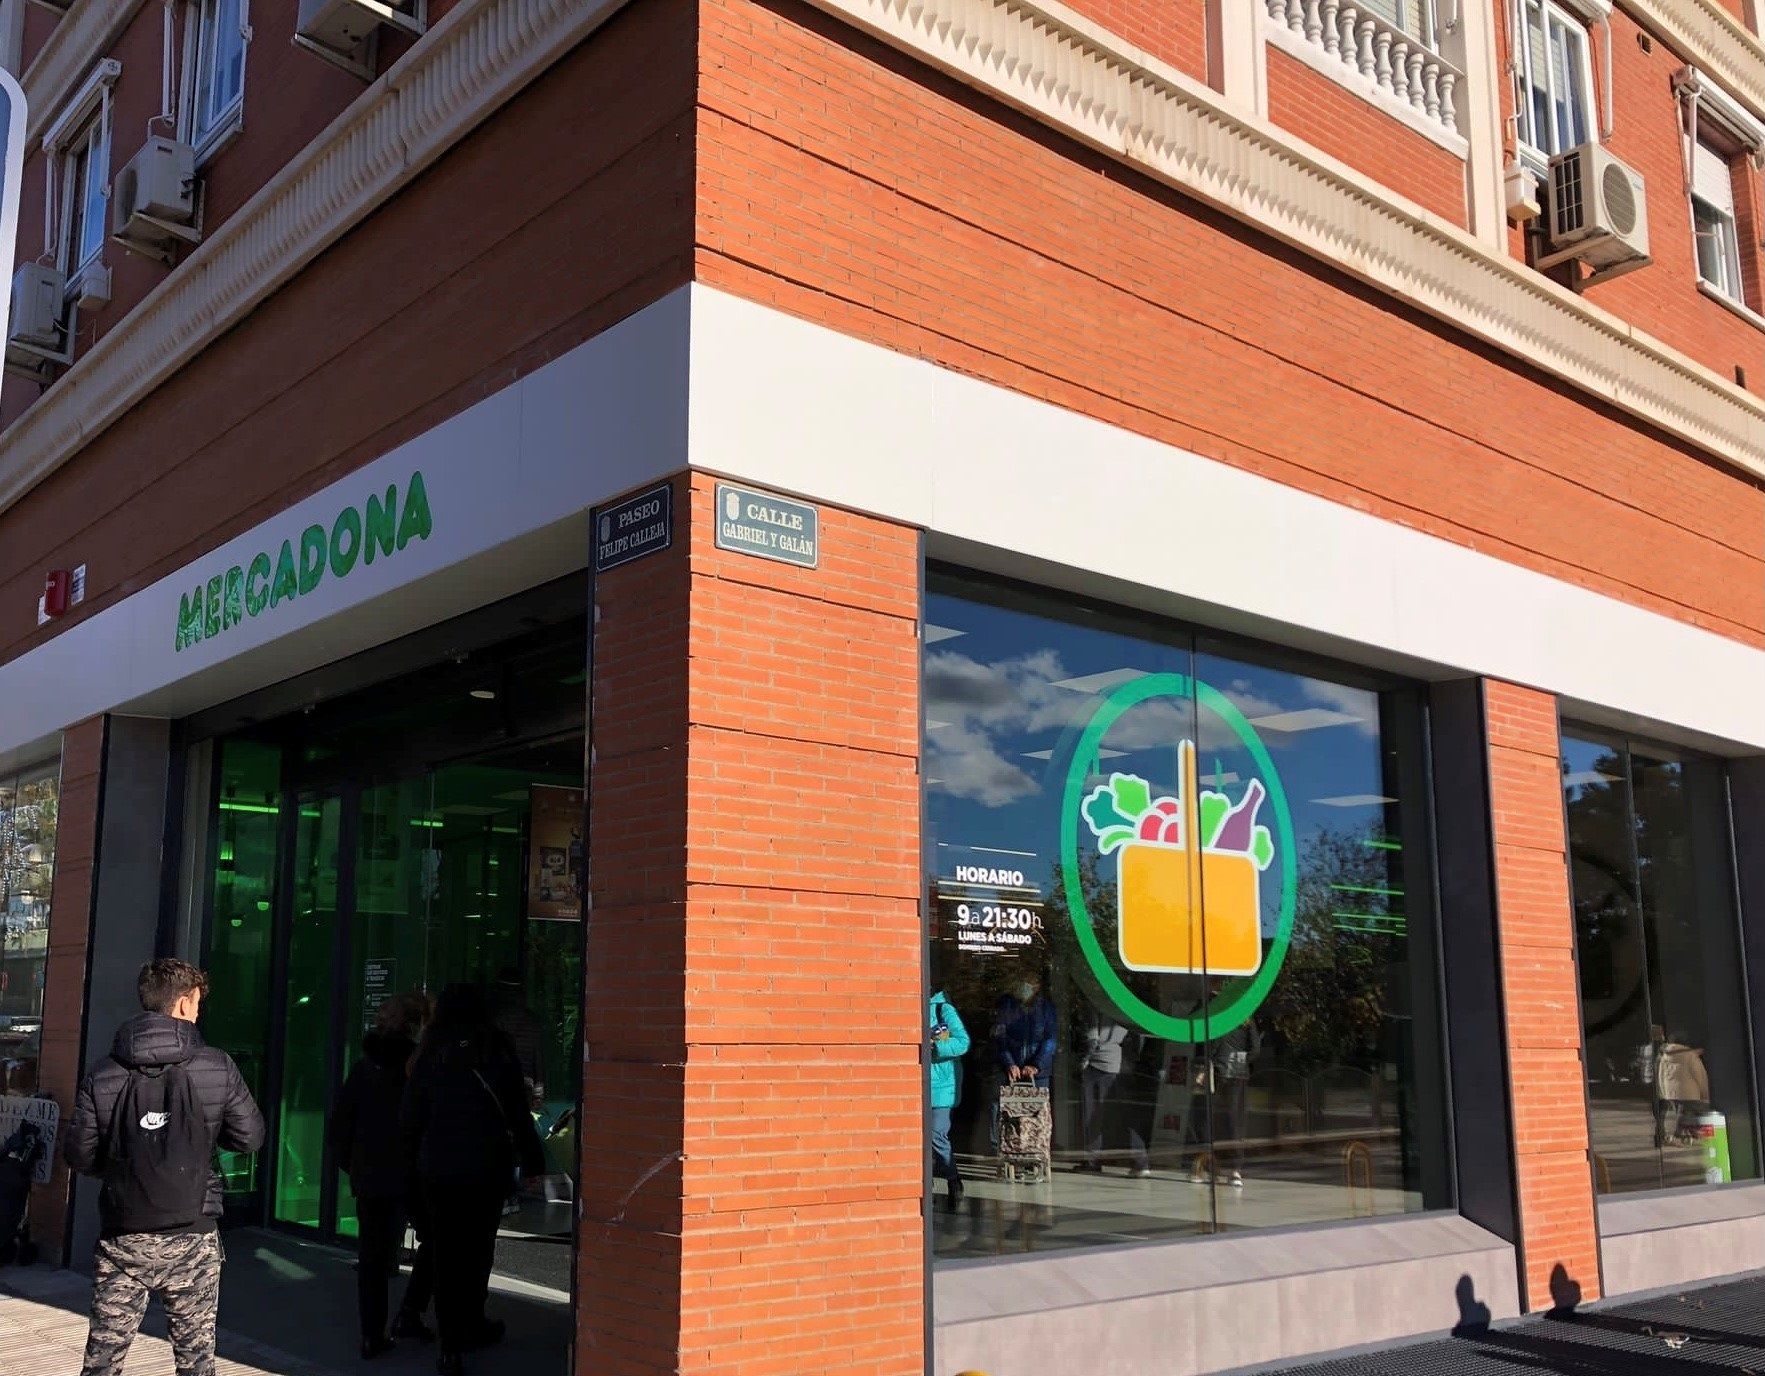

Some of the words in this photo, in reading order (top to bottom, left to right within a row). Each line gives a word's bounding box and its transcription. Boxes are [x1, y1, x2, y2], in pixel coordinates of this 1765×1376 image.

[618, 499, 660, 529] PASEO
[746, 503, 804, 531] CALLE
[599, 535, 629, 560] FELIPE
[630, 521, 665, 549] CALLEJA
[722, 521, 768, 546] GABRIEL
[770, 532, 778, 550] Y
[779, 534, 813, 557] GALÁN
[175, 470, 432, 652] MERCADONA
[956, 866, 1024, 886] HORARIO
[957, 904, 970, 926] 9
[971, 911, 980, 925] a
[958, 931, 986, 943] LUNES
[987, 931, 996, 942] A
[996, 931, 1032, 945] SÁBADO
